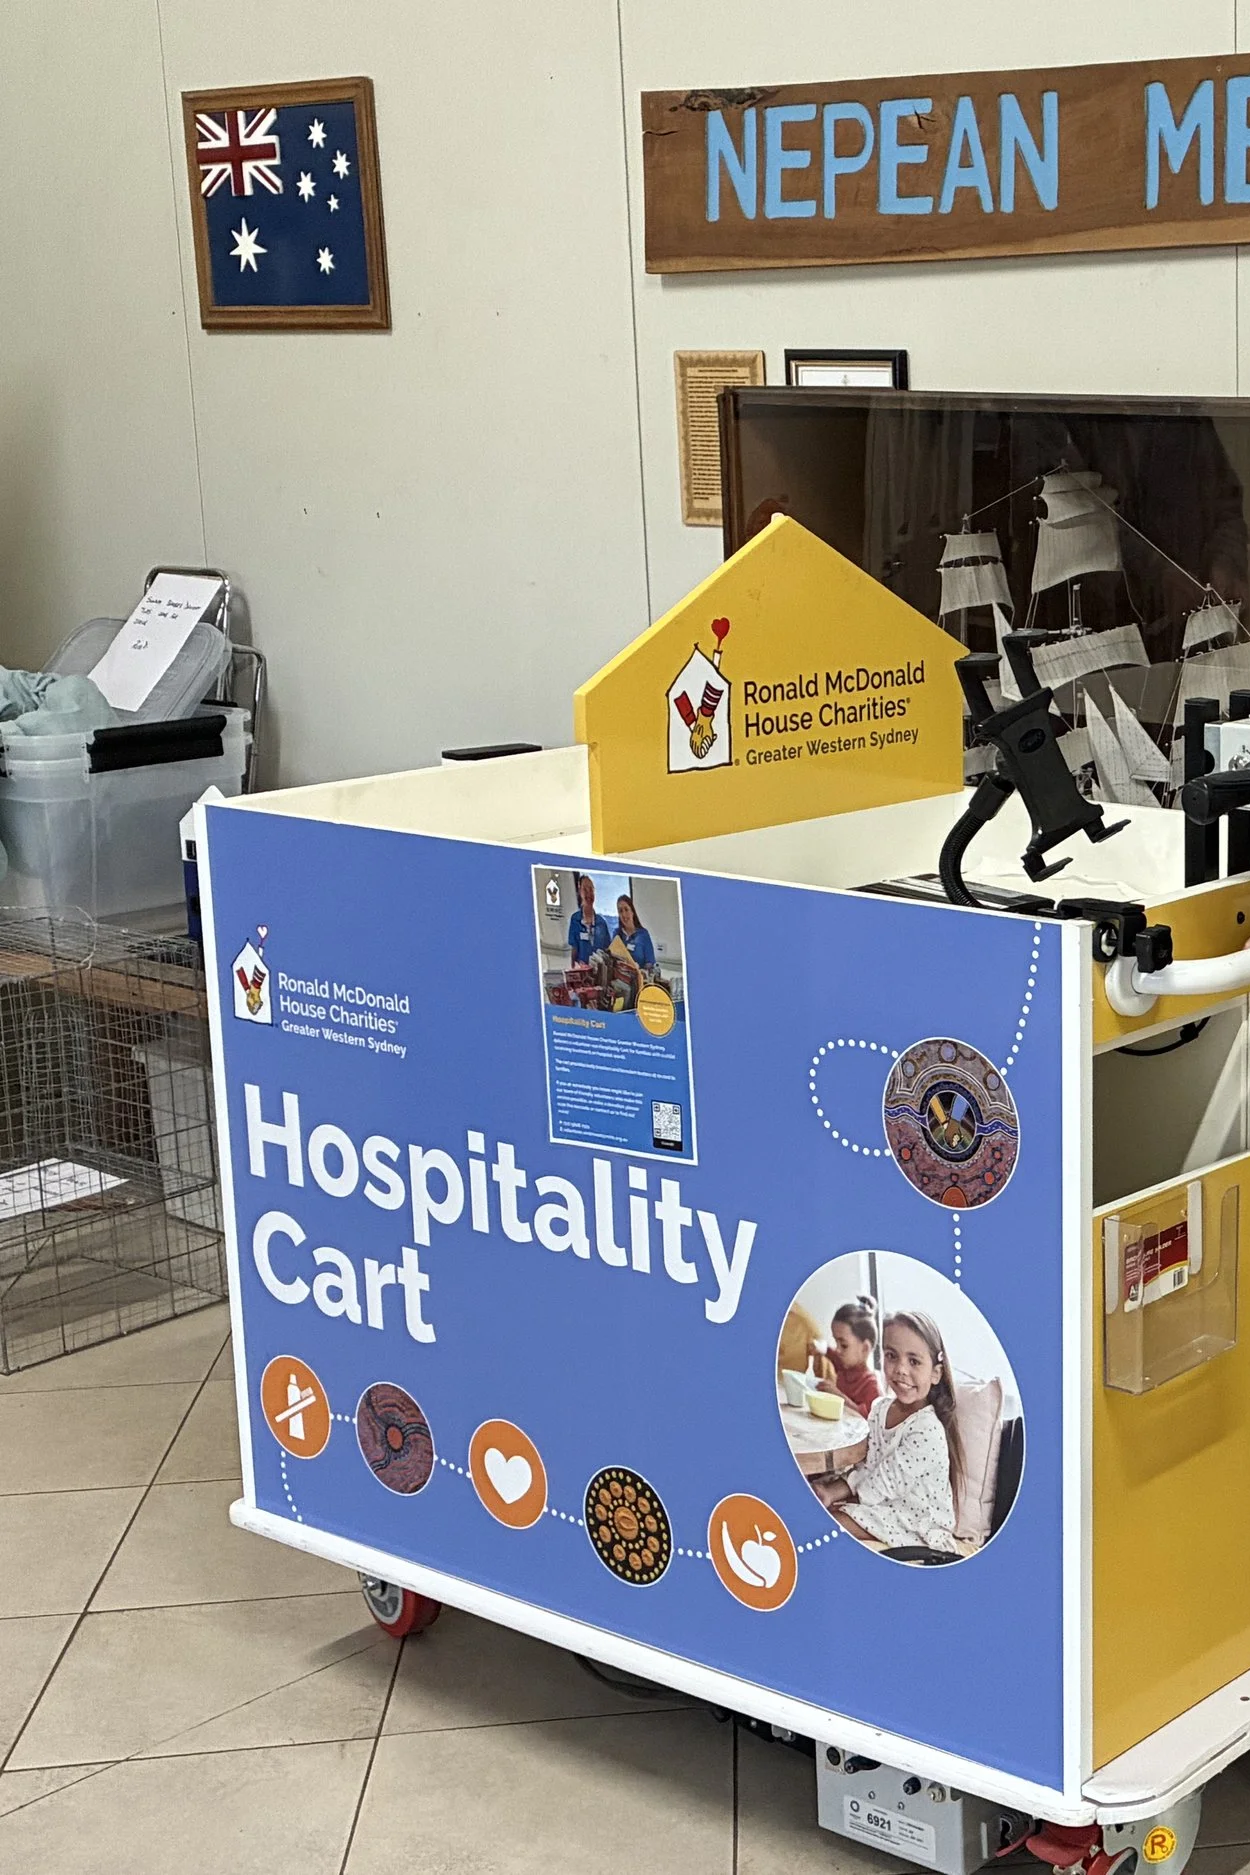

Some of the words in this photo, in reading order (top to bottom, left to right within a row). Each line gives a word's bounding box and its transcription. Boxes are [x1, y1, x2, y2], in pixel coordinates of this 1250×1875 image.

[706, 91, 1059, 222] NEPEAN
[743, 673, 819, 706] Ronald
[824, 659, 925, 694] McDonald
[745, 709, 813, 738] House
[746, 743, 803, 766] Greater
[806, 733, 866, 758] Western
[869, 728, 919, 753] Sydney
[278, 972, 330, 998] Ronald
[333, 982, 410, 1014] McDonald
[279, 995, 327, 1019] House
[281, 1019, 320, 1039] Greater
[322, 1027, 366, 1048] Western
[367, 1036, 407, 1059] Sydney
[243, 1082, 758, 1324] Hospitality
[252, 1209, 437, 1345] Cart
[867, 1813, 891, 1831] 6921
